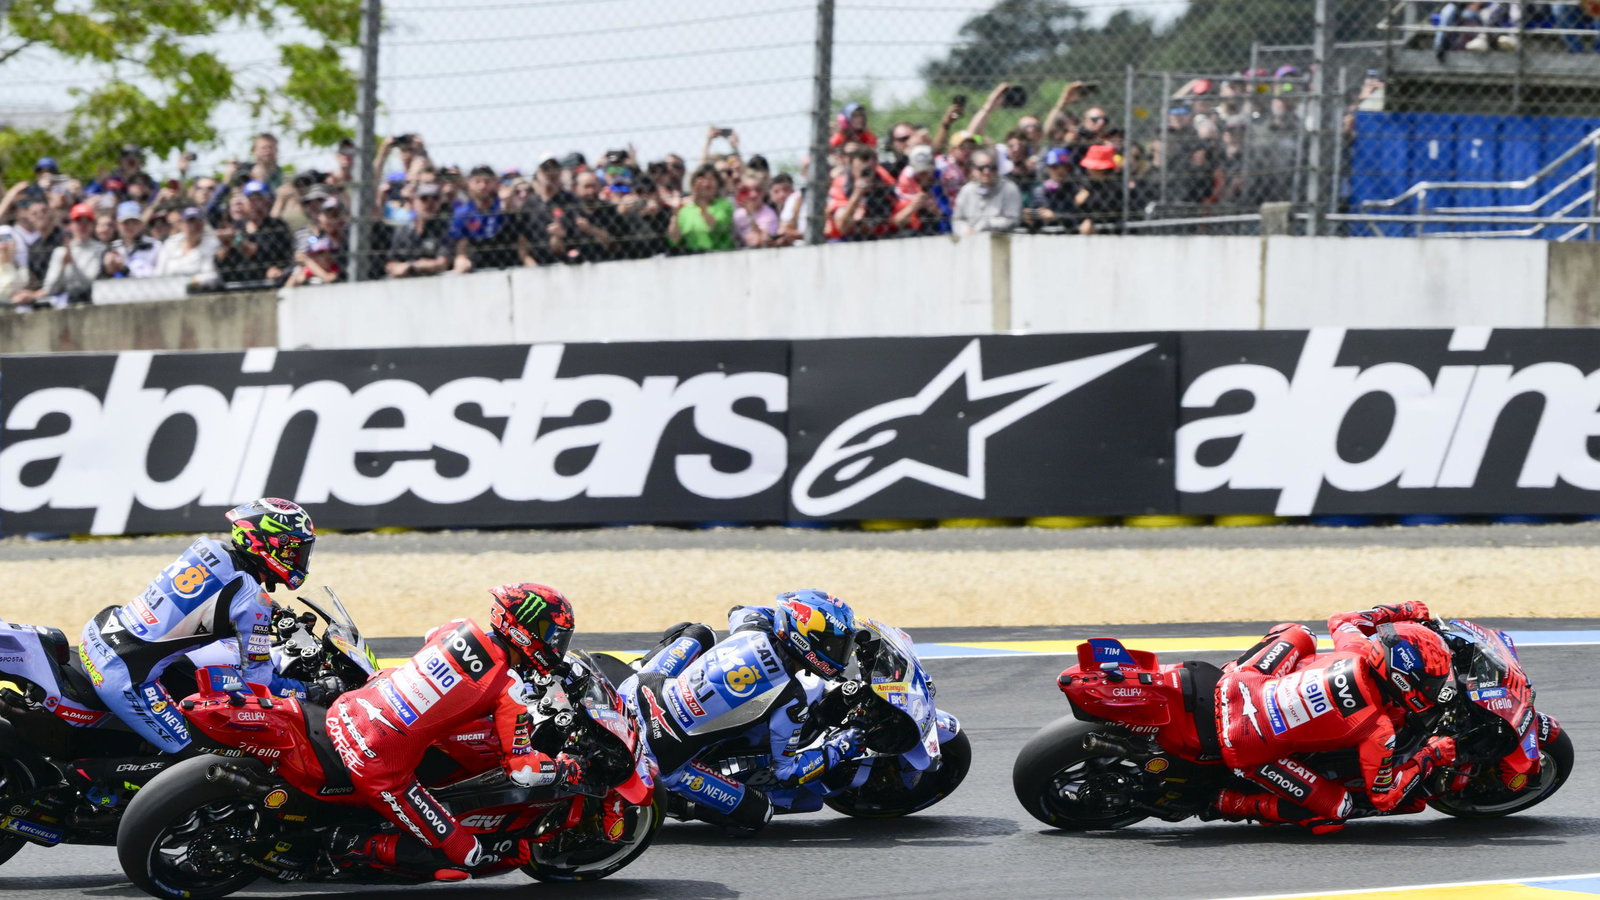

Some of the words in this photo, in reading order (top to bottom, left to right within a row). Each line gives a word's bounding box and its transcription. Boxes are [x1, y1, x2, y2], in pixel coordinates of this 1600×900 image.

[0, 343, 788, 535] alpinestars
[253, 624, 269, 632] BOLD
[86, 626, 114, 662] AINESE
[791, 633, 809, 650] SHOEI
[1104, 647, 1121, 656] TIM
[1259, 641, 1291, 670] Lenovo
[1396, 647, 1415, 669] next
[222, 675, 238, 684] TIM
[1394, 674, 1409, 690] SHOEI
[876, 684, 906, 693] Antangin
[1112, 687, 1142, 697] GELLIFY
[666, 688, 690, 724] MICHELIN
[691, 701, 702, 714] OIL
[1491, 697, 1513, 710] riello
[69, 711, 94, 721] DAIKO
[122, 690, 176, 744] DAINESE
[237, 711, 265, 721] GELLIFY
[1518, 710, 1534, 737] Lenovo
[161, 711, 189, 740] NEWS
[1124, 723, 1160, 734] riello
[1538, 714, 1549, 742] Leno
[456, 733, 485, 741] DUCATI
[246, 745, 281, 758] riello
[114, 761, 165, 772] DAINESE
[695, 762, 738, 786] DAIKO
[1259, 764, 1304, 798] Lenovo
[320, 786, 354, 794] Lenovo
[703, 783, 738, 807] NEWS
[407, 785, 447, 834] Lenovo
[380, 790, 433, 847] alpinestars
[460, 814, 507, 831] GIVI
[19, 824, 59, 840] MICHELIN
